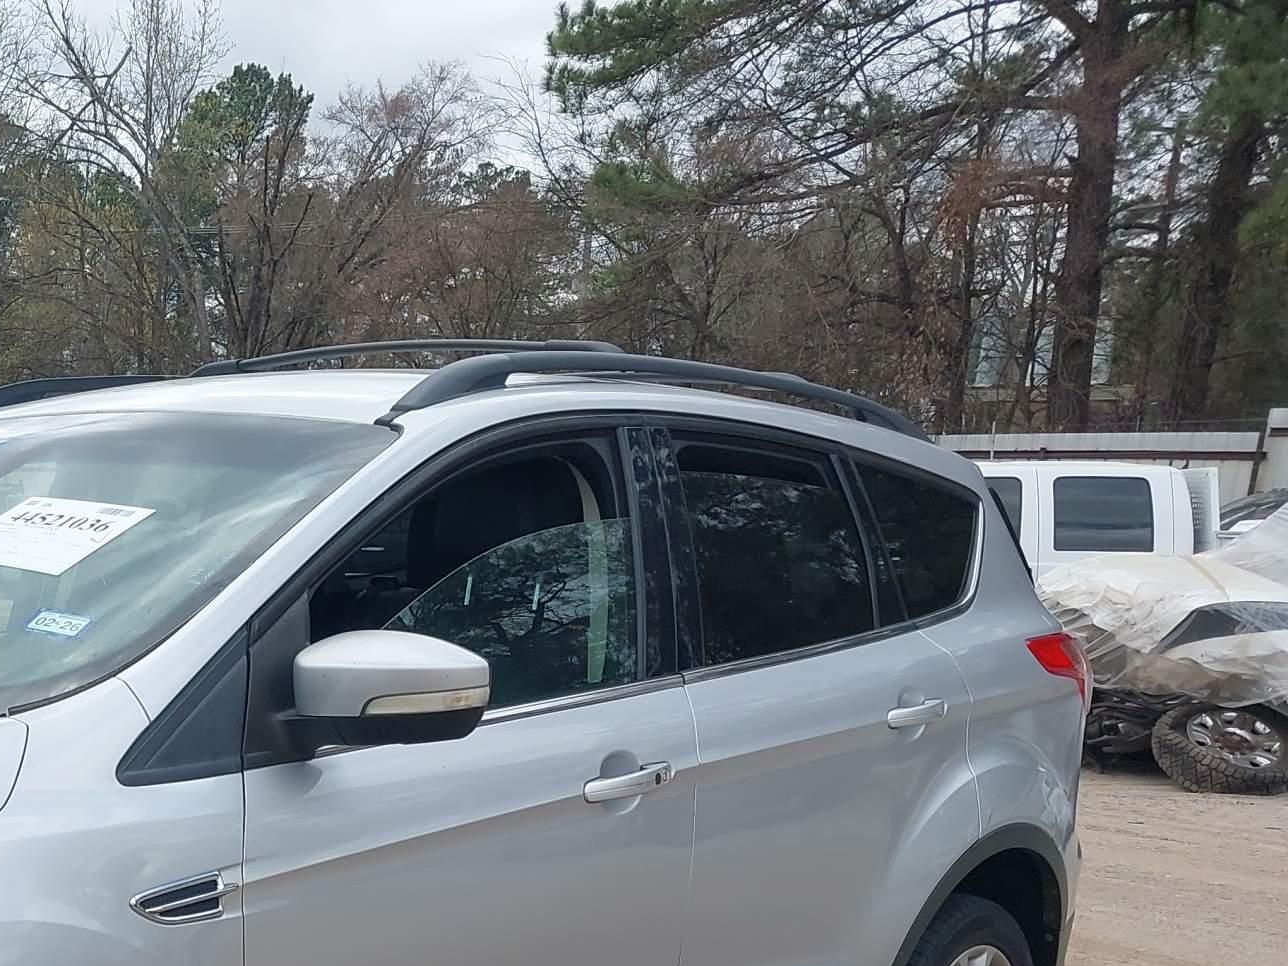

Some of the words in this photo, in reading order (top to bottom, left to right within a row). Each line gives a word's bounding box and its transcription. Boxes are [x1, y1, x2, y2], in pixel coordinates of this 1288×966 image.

[10, 511, 115, 535] 44521036
[34, 616, 57, 628] 02
[58, 620, 82, 632] 26
